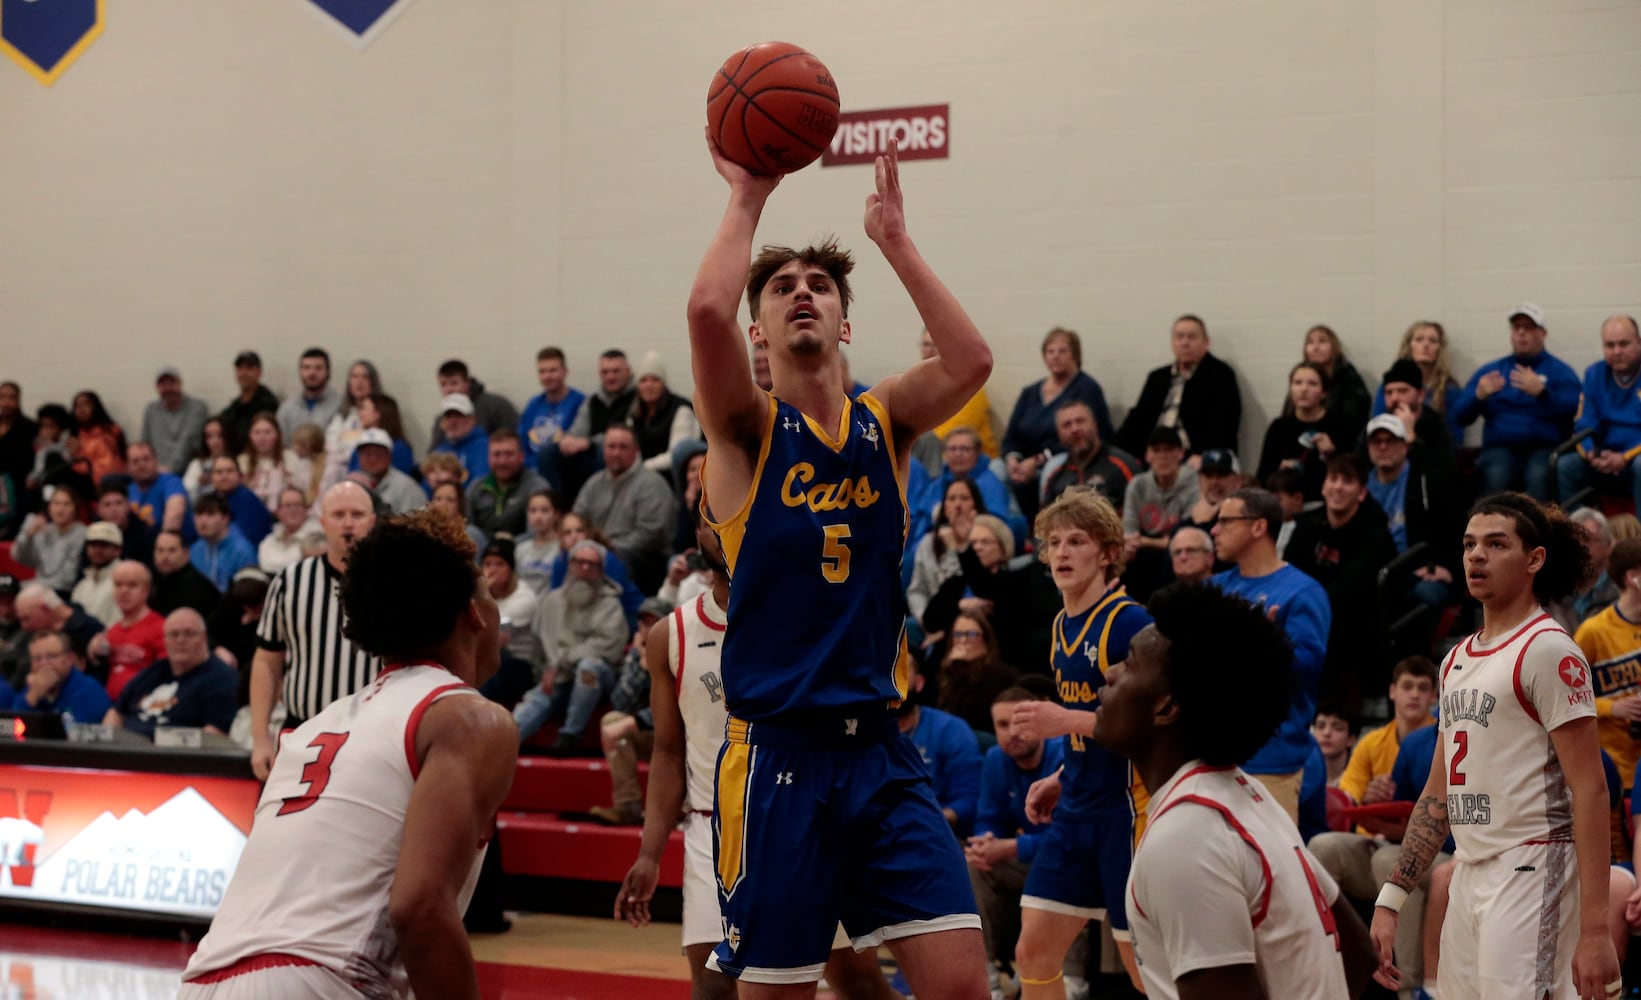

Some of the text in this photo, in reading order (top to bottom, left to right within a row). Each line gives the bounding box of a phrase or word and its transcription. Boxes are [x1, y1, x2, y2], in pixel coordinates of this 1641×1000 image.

[829, 115, 946, 156] VISITORS
[821, 523, 852, 583] 5
[1442, 688, 1496, 728] POLAR
[276, 731, 350, 816] 3
[1449, 730, 1468, 785] 2
[1447, 794, 1491, 825] EARS
[60, 858, 227, 908] POLAR BEARS
